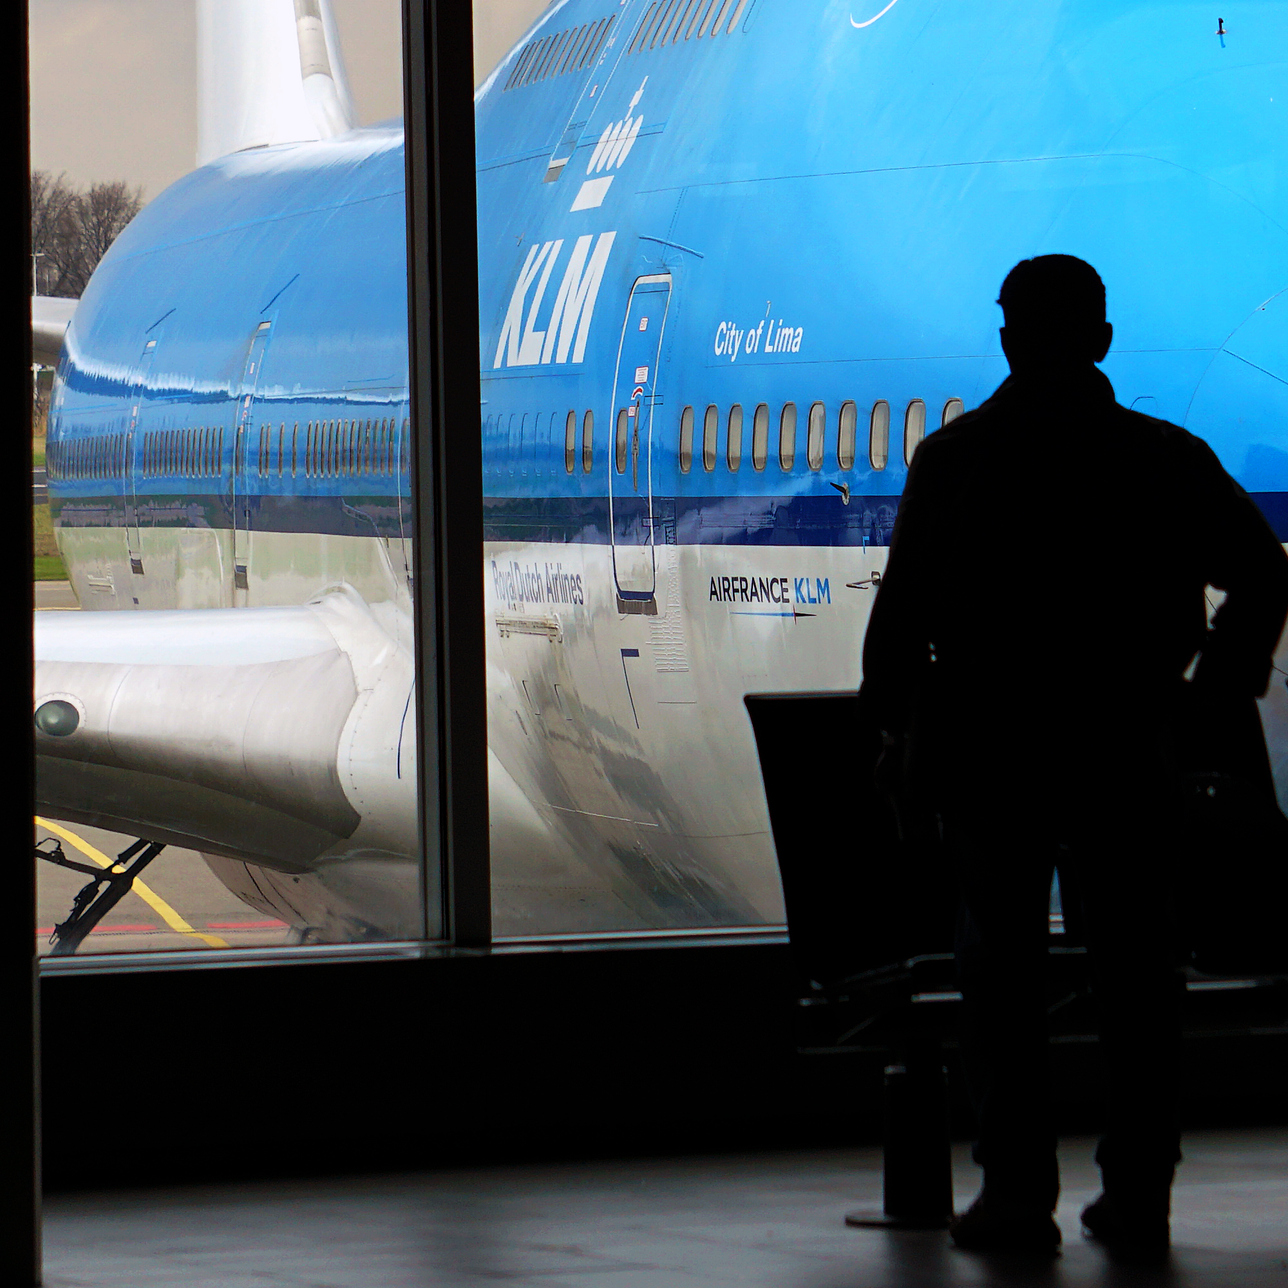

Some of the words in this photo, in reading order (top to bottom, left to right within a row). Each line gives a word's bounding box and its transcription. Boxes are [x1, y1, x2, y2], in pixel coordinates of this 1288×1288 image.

[493, 230, 618, 369] KLM
[714, 320, 744, 362] City
[745, 319, 765, 354] of
[764, 318, 804, 353] Lima
[492, 560, 517, 610] Royal
[514, 561, 545, 603] Dutch
[545, 562, 584, 605] Airlines
[709, 576, 790, 604] AIRFRANCE
[794, 577, 831, 604] KLM
